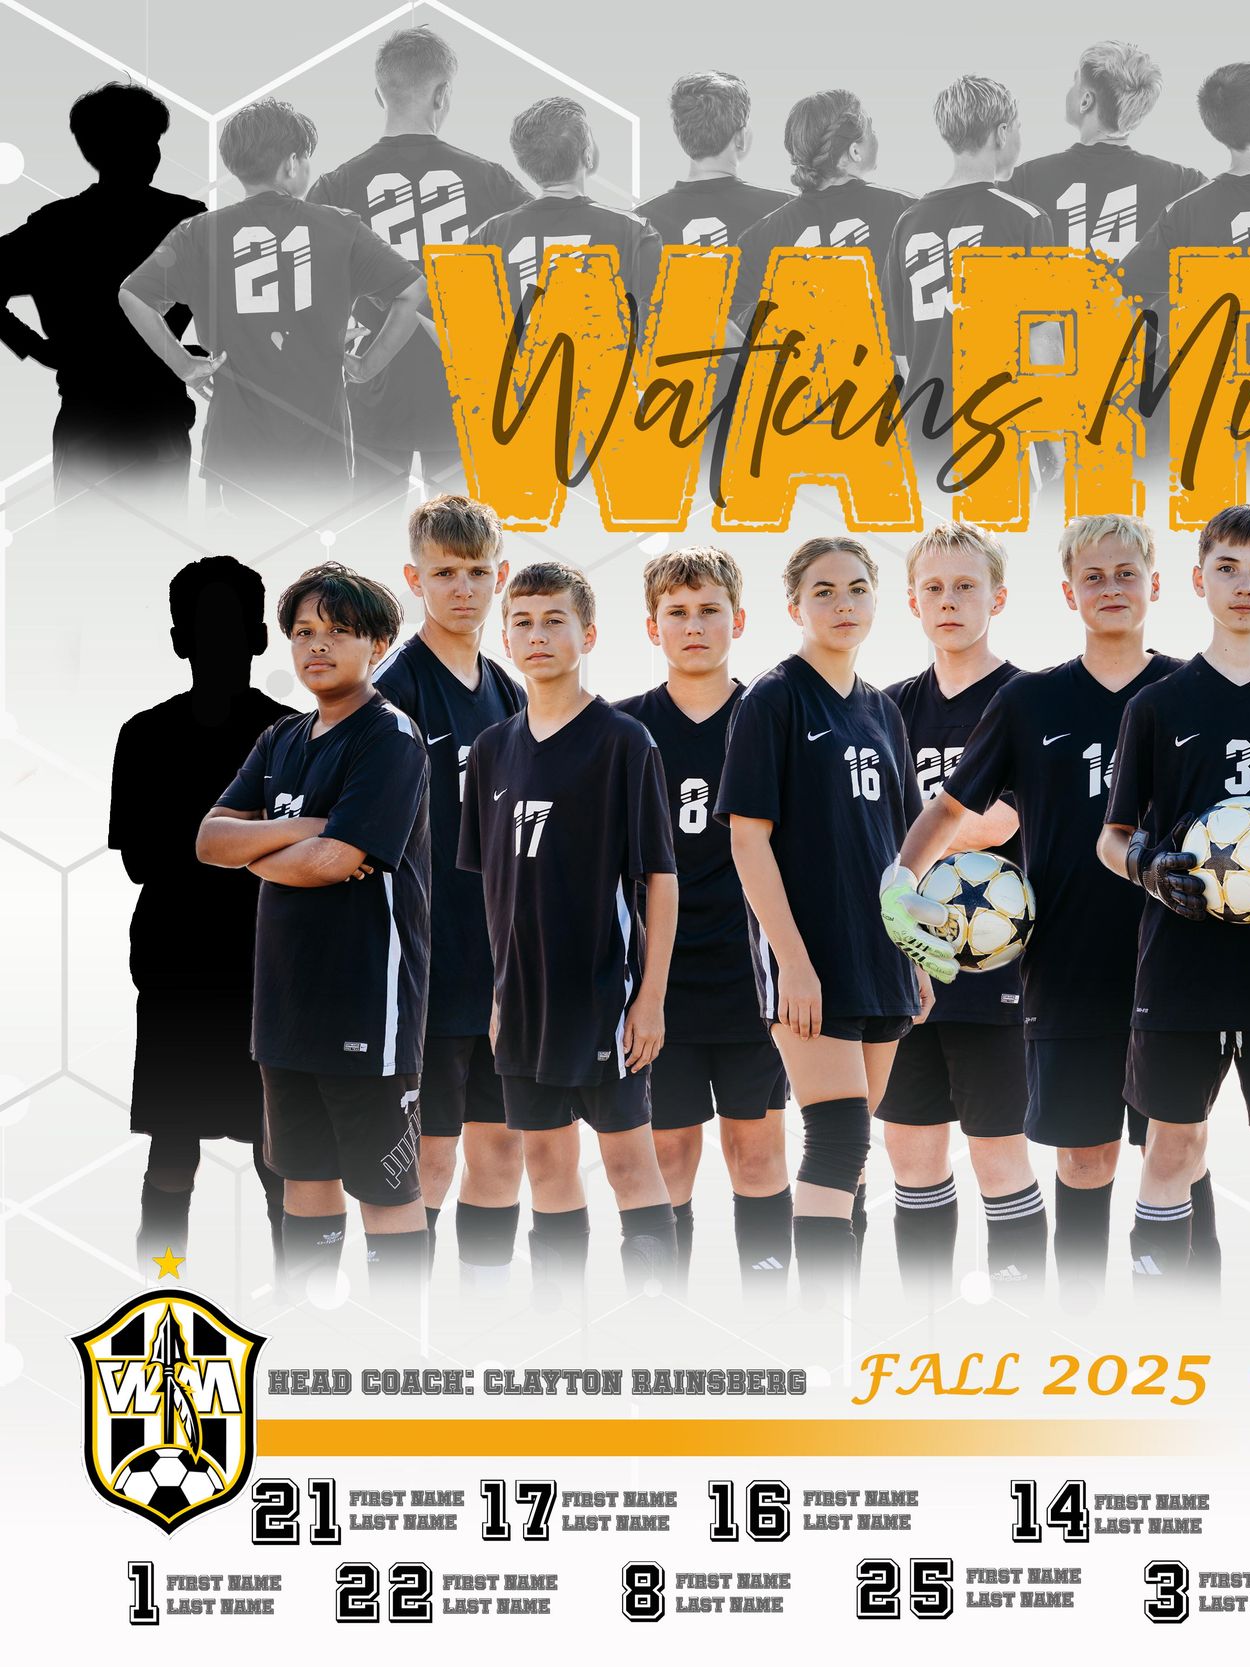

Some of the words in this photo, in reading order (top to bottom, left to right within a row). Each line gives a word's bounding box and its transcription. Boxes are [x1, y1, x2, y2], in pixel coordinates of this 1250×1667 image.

[366, 170, 470, 261] 22
[1056, 182, 1139, 263] 14
[232, 226, 312, 314] 21
[678, 778, 708, 834] 8
[843, 745, 881, 801] 16
[513, 800, 554, 857] 17
